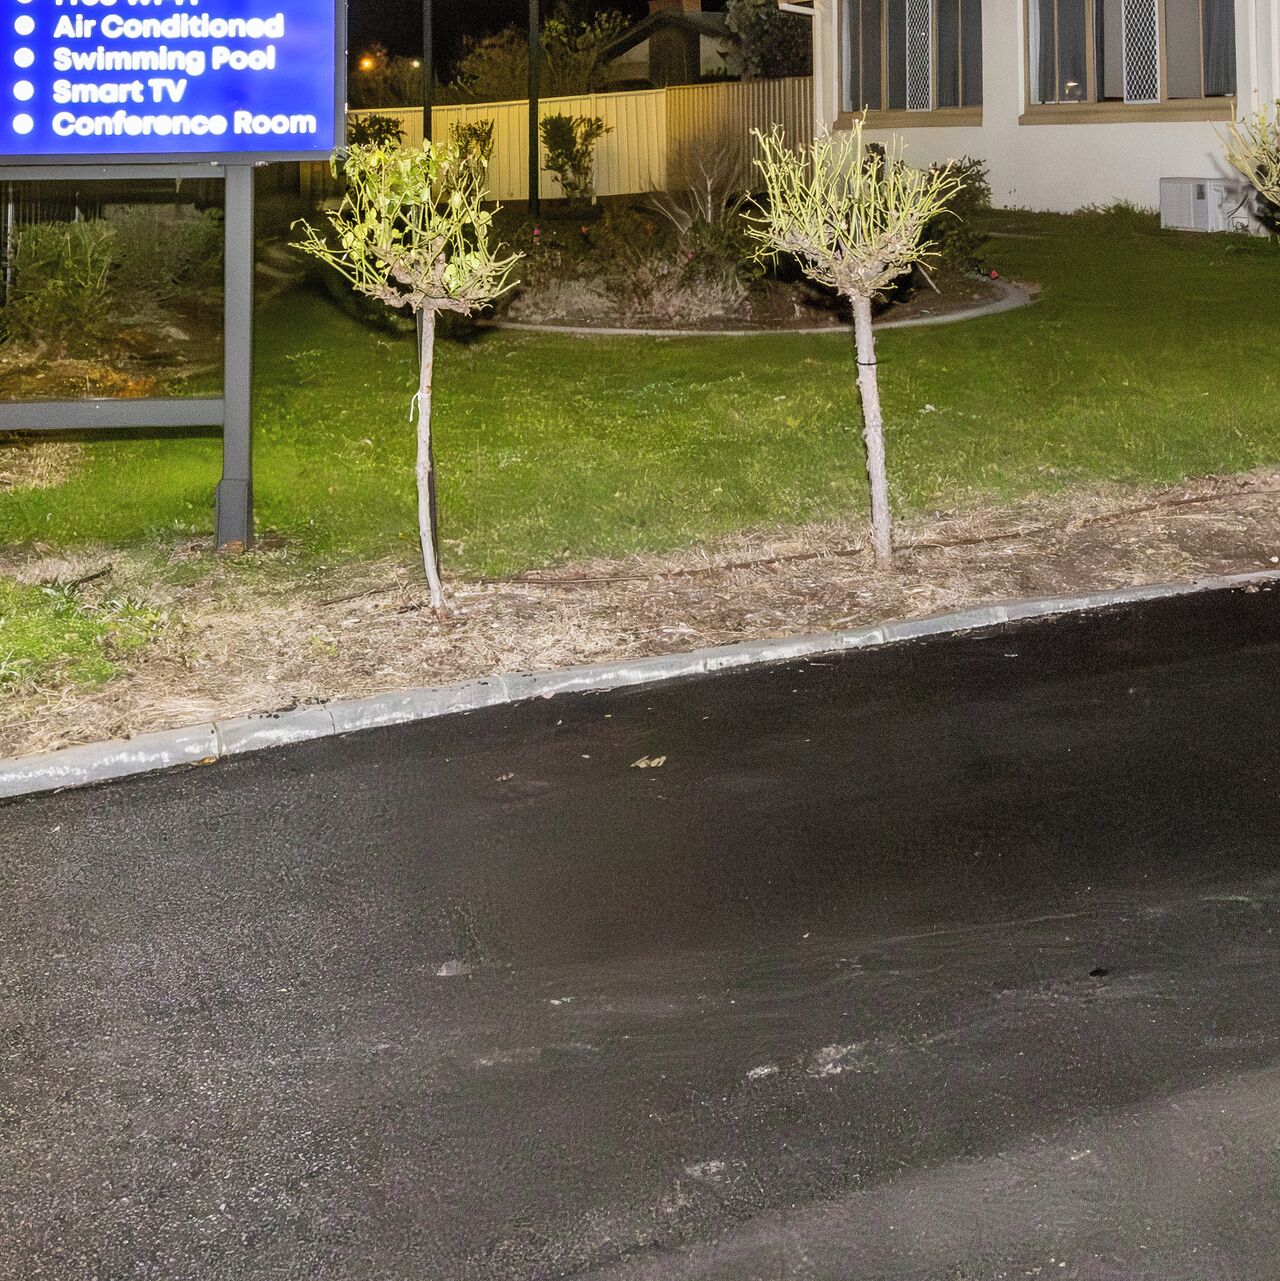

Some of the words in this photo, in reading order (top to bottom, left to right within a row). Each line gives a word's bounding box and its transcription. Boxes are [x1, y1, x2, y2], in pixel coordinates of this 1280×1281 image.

[53, 14, 97, 38] Air
[101, 13, 285, 39] Conditioned
[53, 46, 205, 77] Swimming
[211, 45, 276, 70] Pool
[52, 79, 144, 104] Smart
[148, 78, 188, 103] TV
[52, 110, 228, 137] Conference
[233, 110, 317, 134] Room
